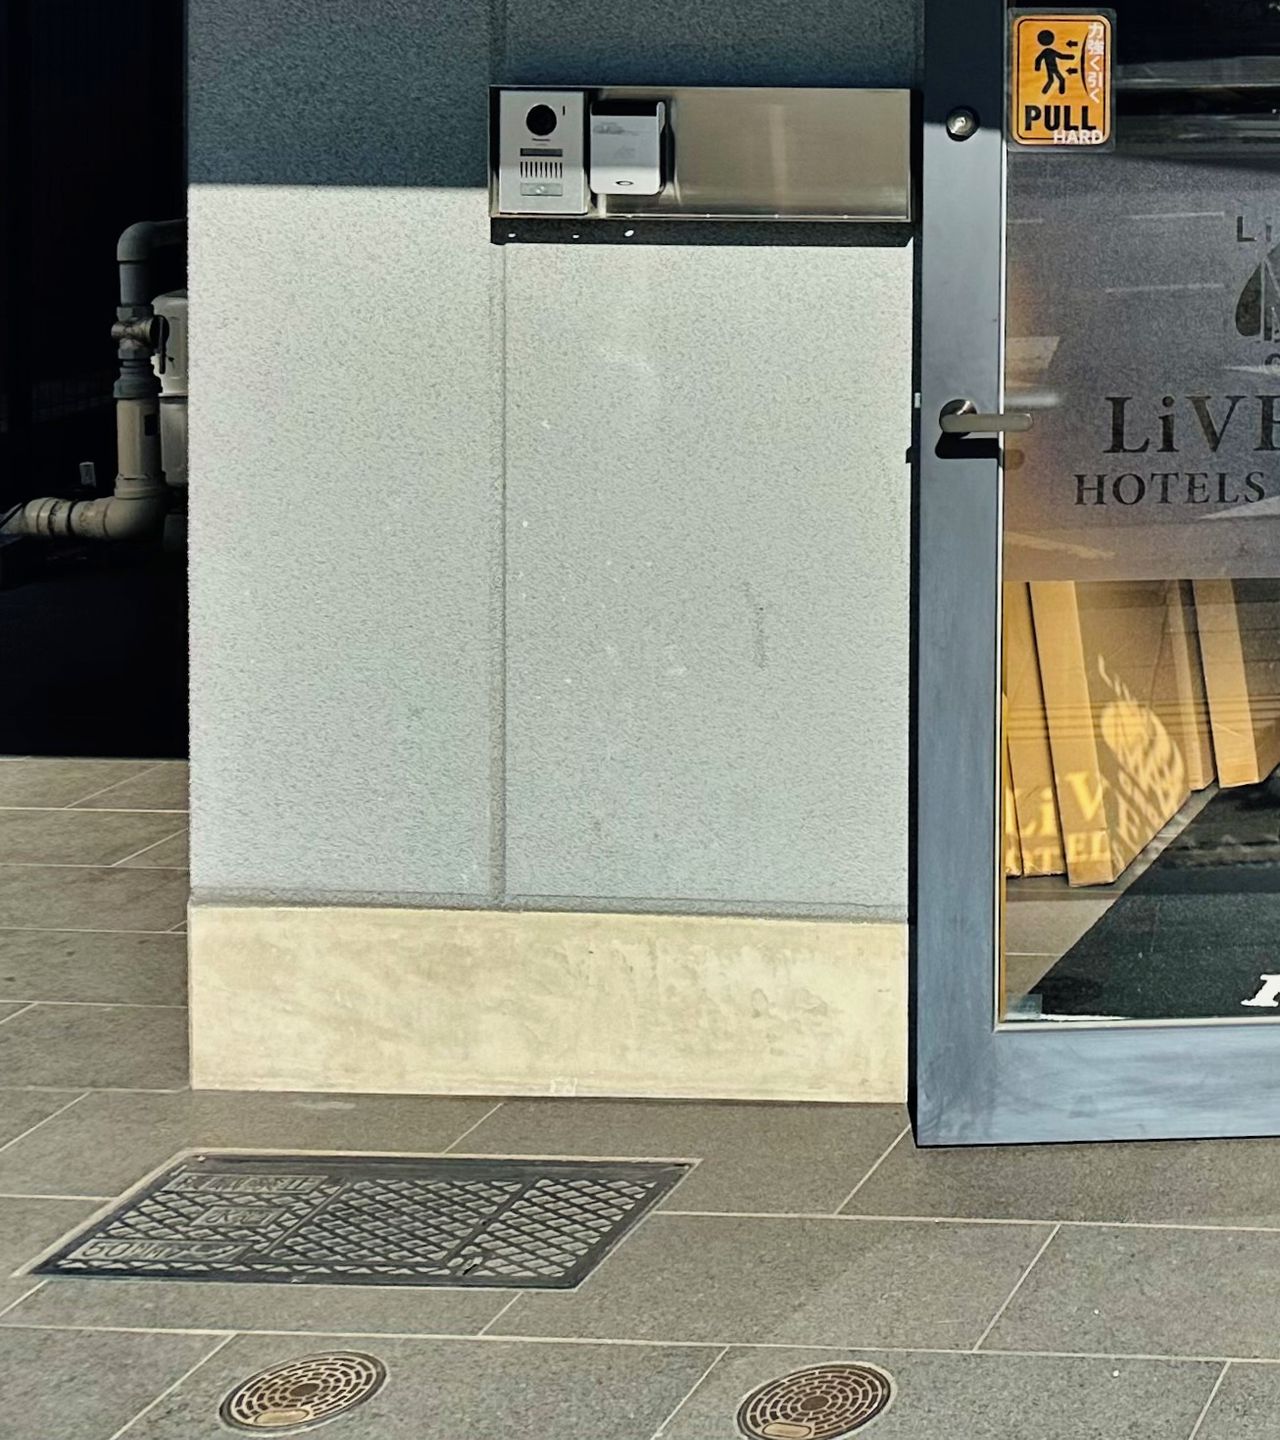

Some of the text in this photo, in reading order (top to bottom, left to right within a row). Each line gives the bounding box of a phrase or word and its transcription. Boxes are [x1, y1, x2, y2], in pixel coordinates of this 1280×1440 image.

[1087, 22, 1105, 104] 力強く引く
[1024, 105, 1097, 131] PULL
[1053, 129, 1104, 145] HARD
[1074, 471, 1266, 506] HOTELS
